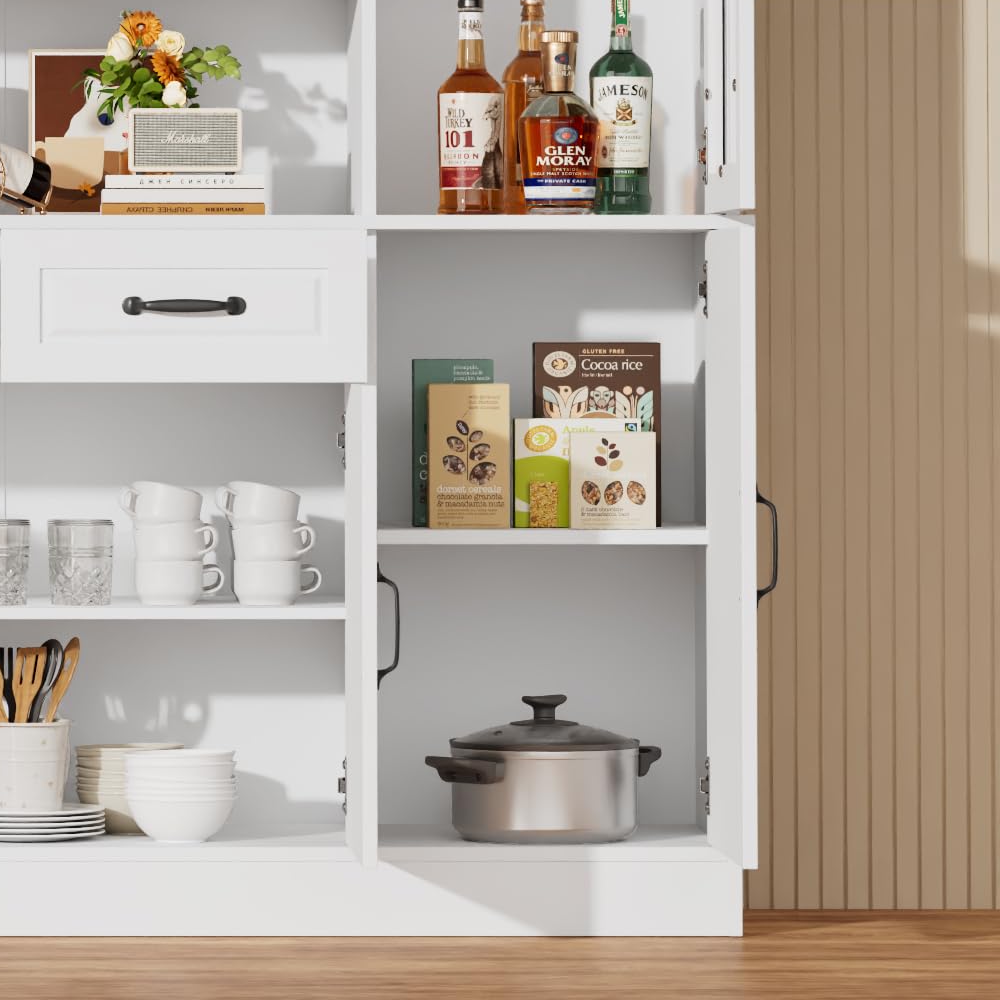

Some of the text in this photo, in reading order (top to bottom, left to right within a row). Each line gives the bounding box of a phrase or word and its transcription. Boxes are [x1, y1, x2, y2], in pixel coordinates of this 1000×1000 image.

[598, 84, 648, 102] JAMESON
[160, 130, 211, 144] Marshall
[445, 130, 476, 148] 101
[544, 145, 586, 156] GLEN
[535, 155, 593, 166] MORAY
[581, 358, 618, 371] Cocoa
[621, 358, 643, 371] rice
[474, 493, 503, 501] granola
